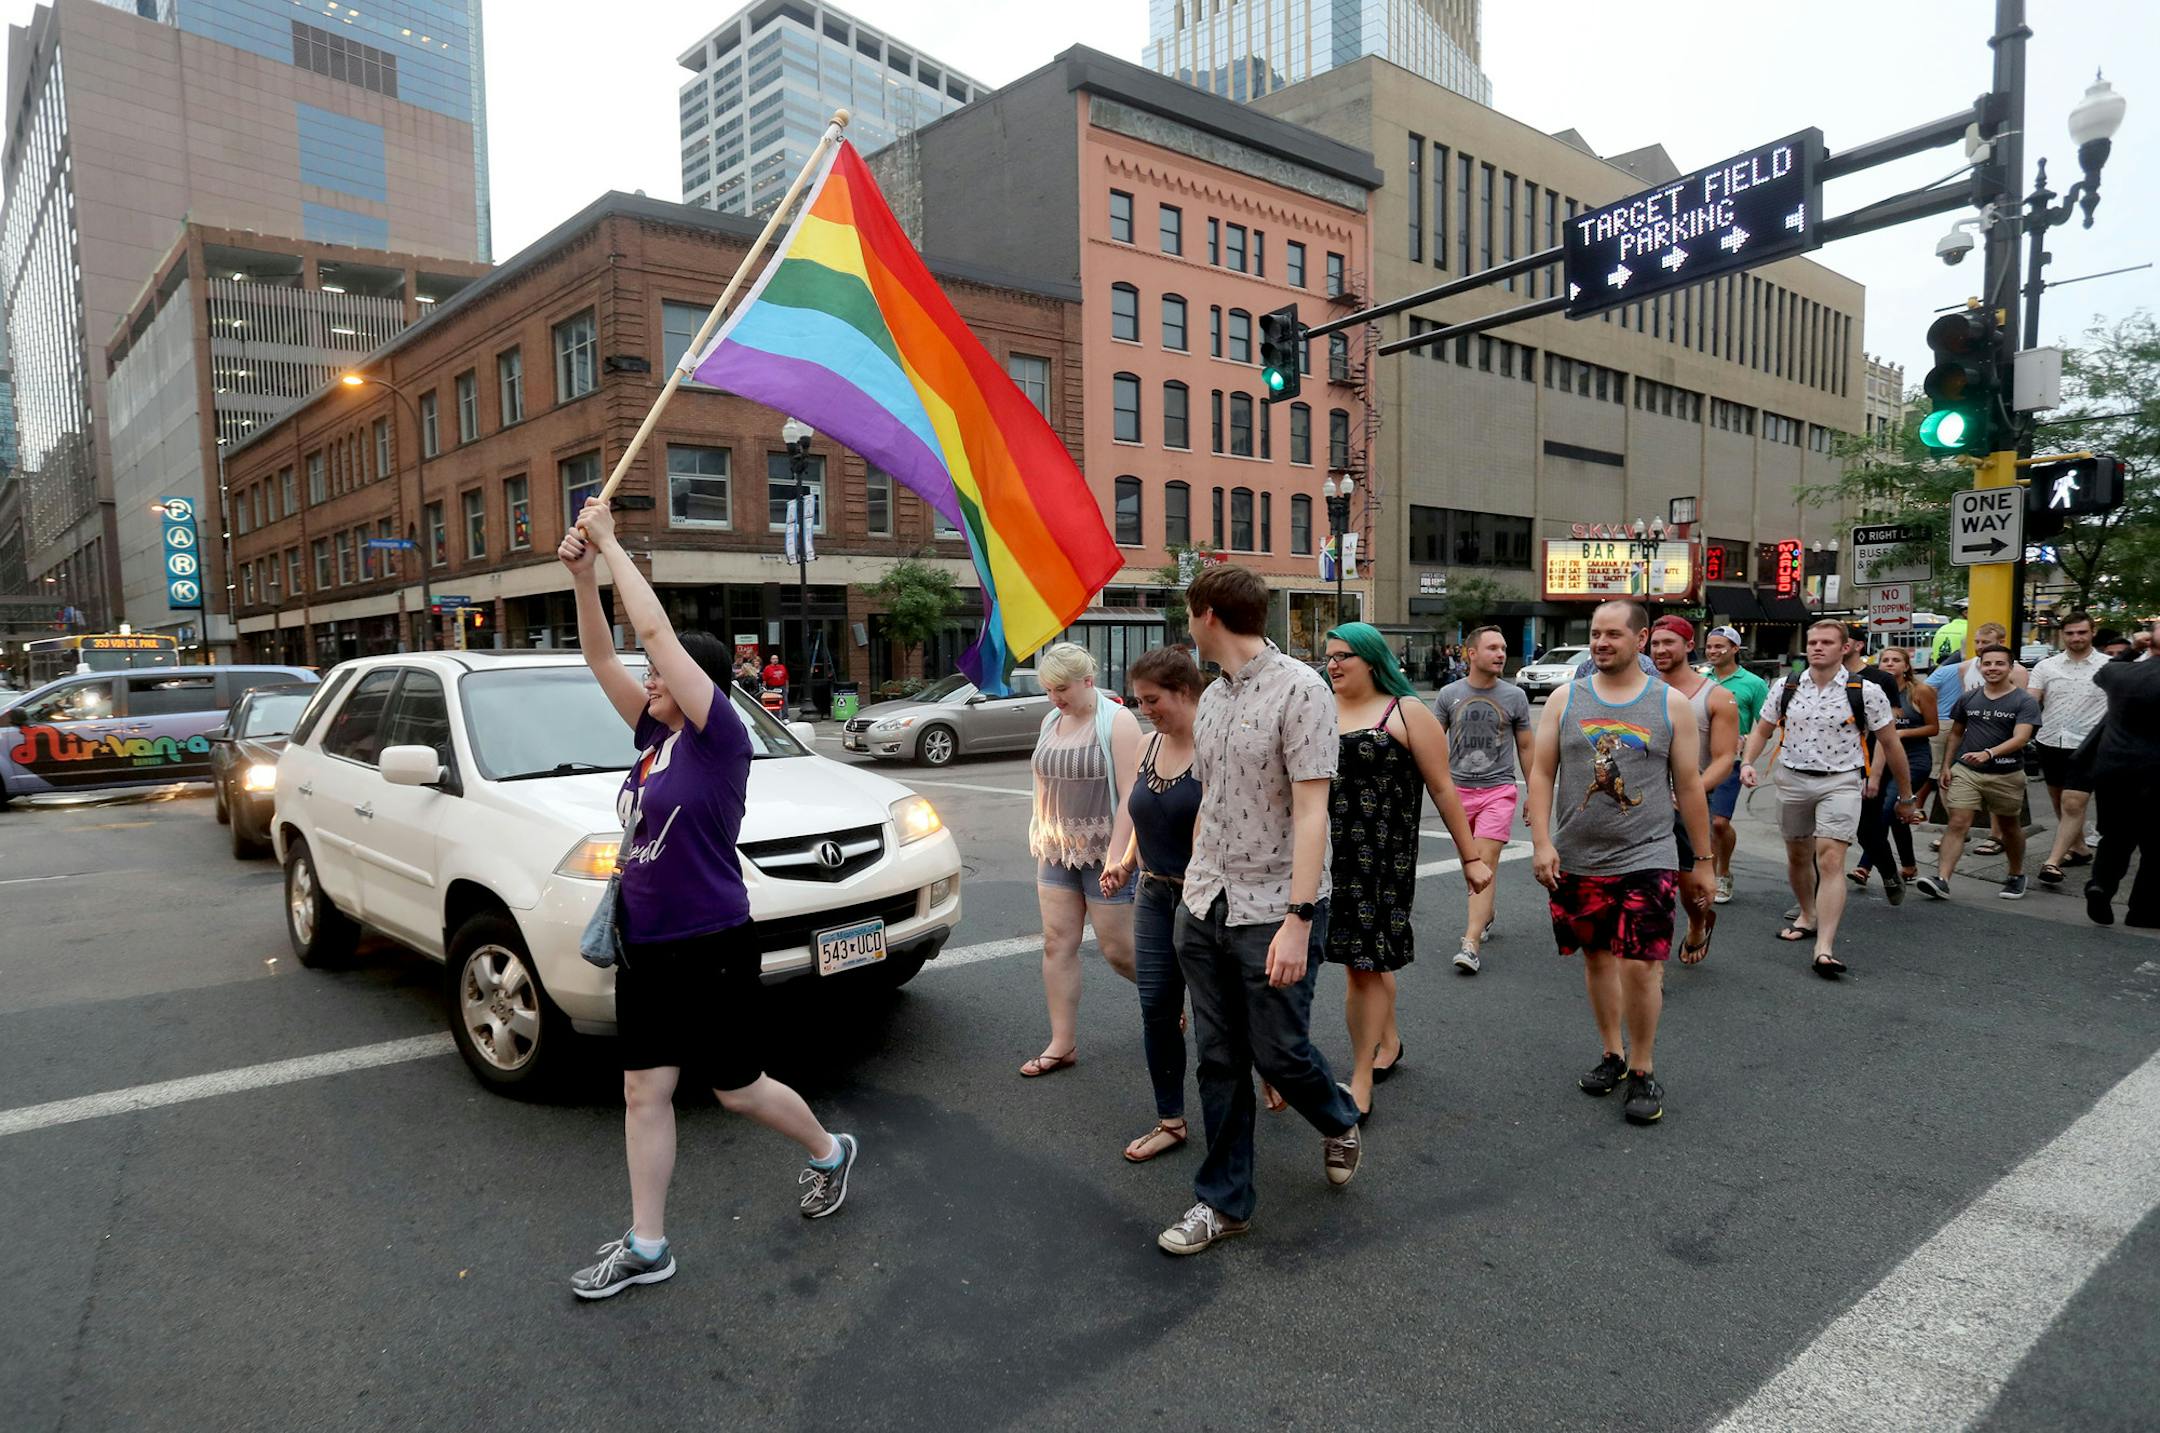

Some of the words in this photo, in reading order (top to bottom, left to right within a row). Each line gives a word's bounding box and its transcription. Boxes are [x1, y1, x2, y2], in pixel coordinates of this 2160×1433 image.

[1577, 184, 1685, 247] TARGET
[1703, 146, 1792, 204] FIELD
[1620, 198, 1735, 261] PARKING
[1963, 492, 2012, 513] ONE
[1961, 512, 2013, 534] WAY
[1868, 529, 1898, 541] RIGHT
[1900, 527, 1926, 539] LAE
[169, 501, 195, 600] PARK
[1582, 543, 1616, 559] BAR
[1859, 547, 1890, 559] BUSE
[1778, 543, 1795, 592] MARUSO
[1857, 561, 1865, 570] &
[1881, 588, 1900, 601] NO
[1872, 603, 1911, 615] STOPPING
[94, 639, 109, 648] 353
[1983, 708, 1991, 717] is
[1993, 708, 2016, 719] love
[1464, 735, 1493, 749] LOVE
[823, 940, 848, 964] 543
[857, 931, 882, 955] UCD
